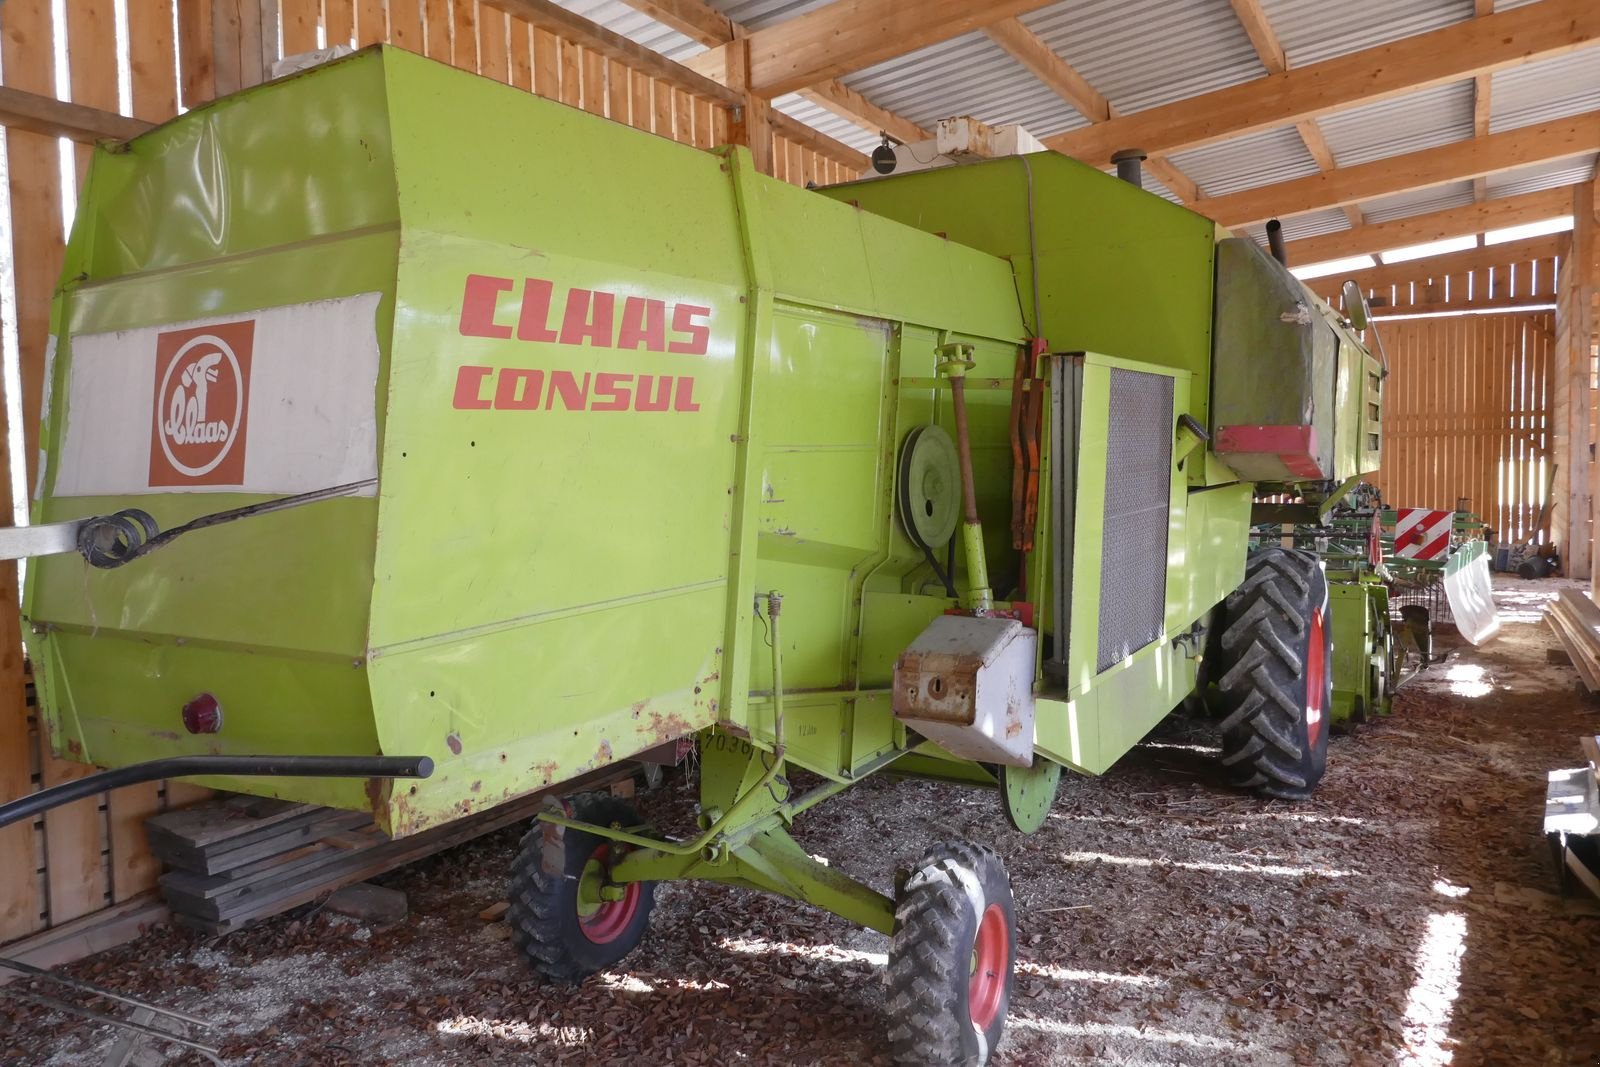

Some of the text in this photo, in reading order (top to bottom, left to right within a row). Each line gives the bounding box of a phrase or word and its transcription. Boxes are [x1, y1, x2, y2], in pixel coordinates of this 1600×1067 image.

[459, 274, 710, 355] CLAAS
[165, 385, 229, 446] Claas
[453, 365, 700, 411] CONSUL
